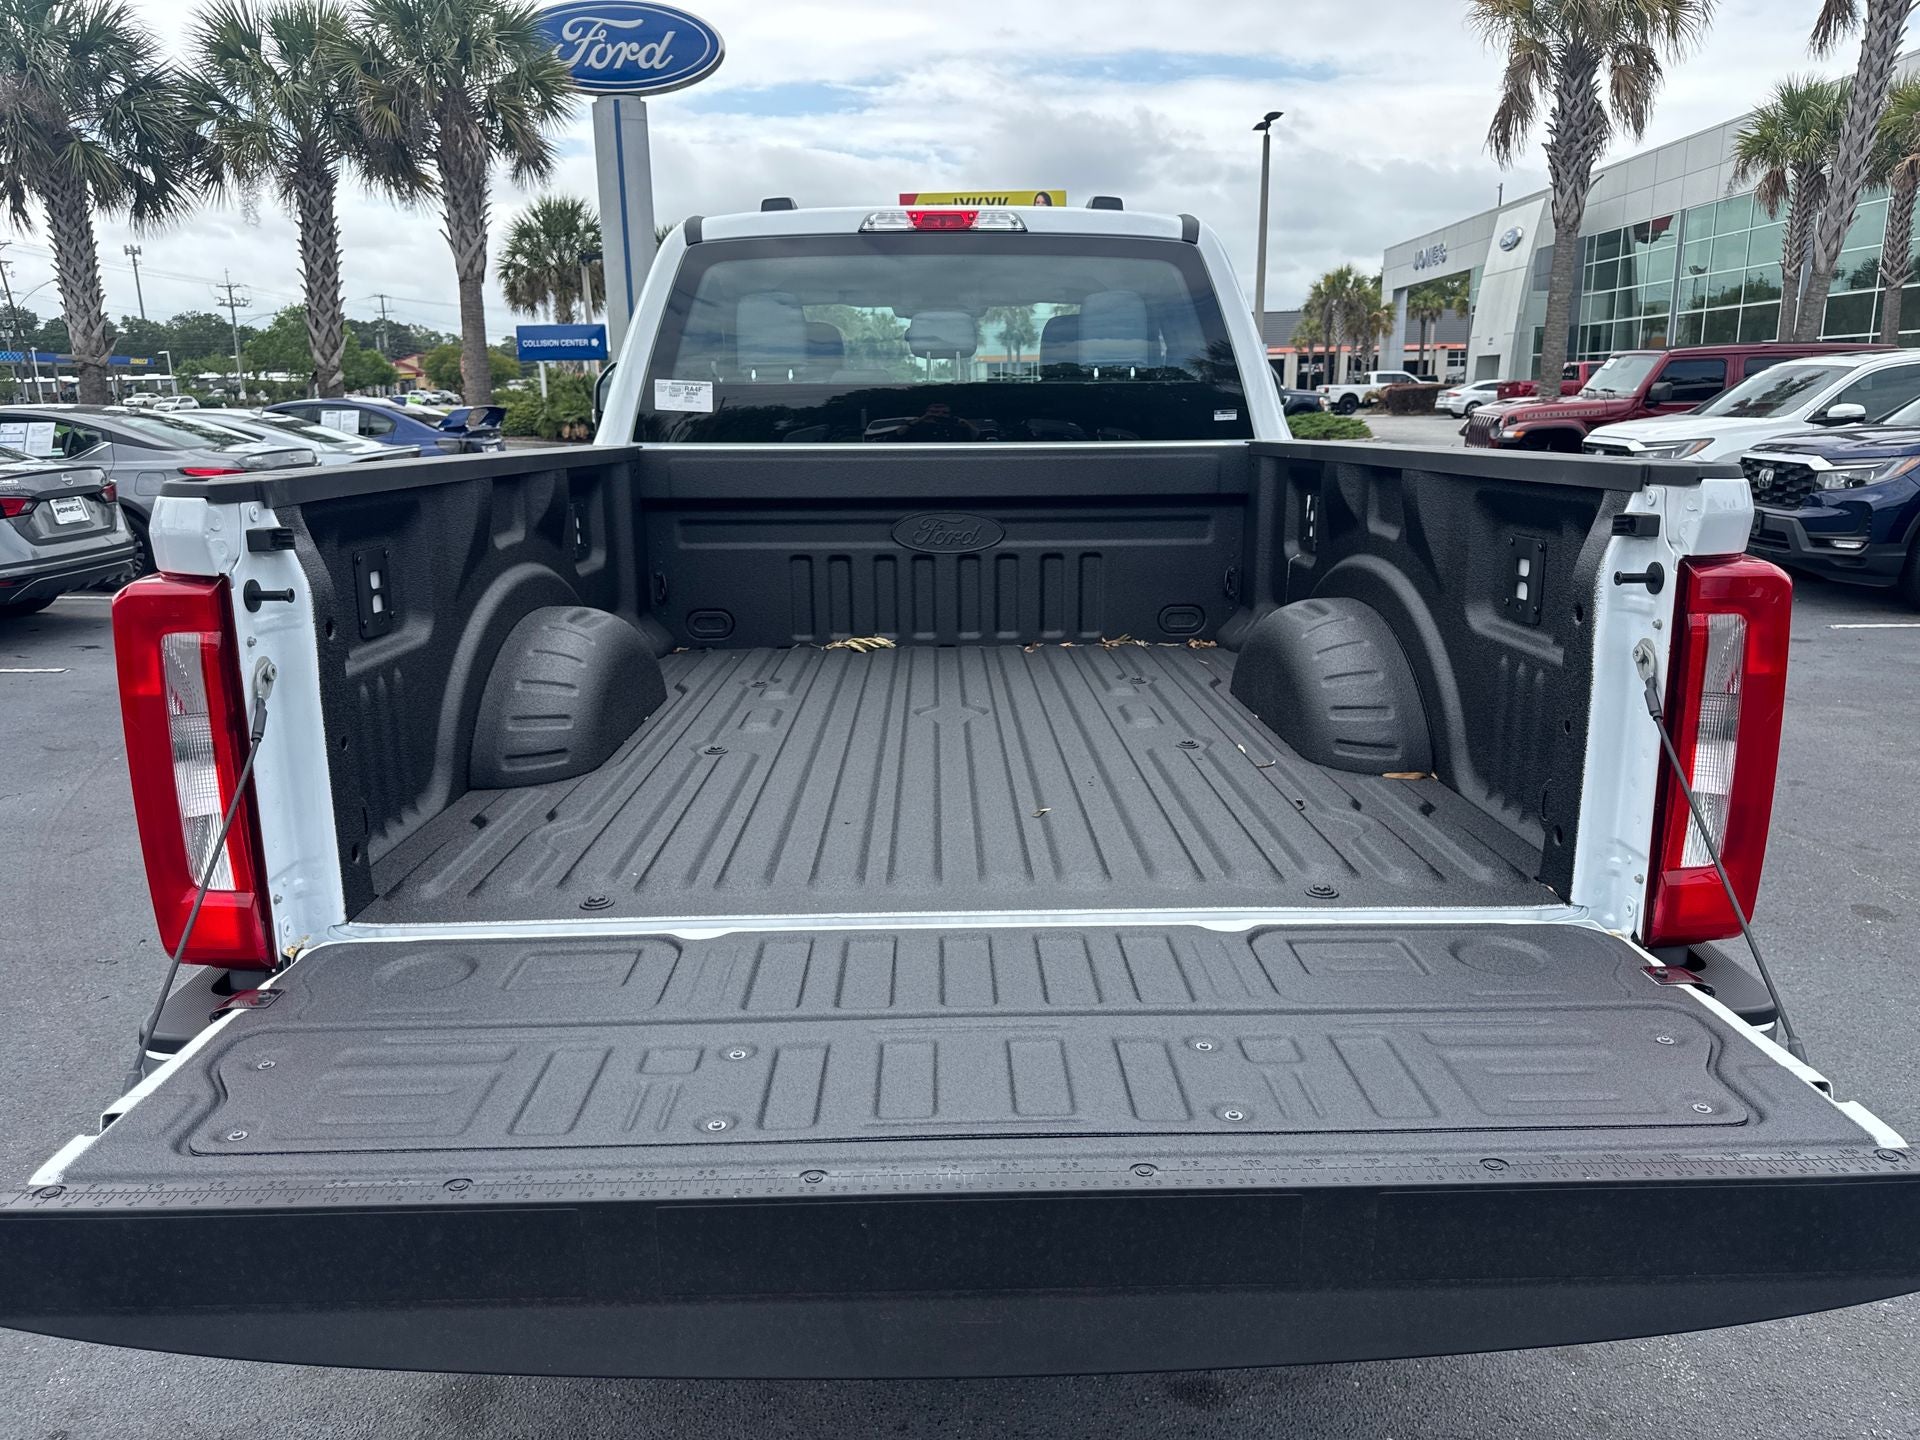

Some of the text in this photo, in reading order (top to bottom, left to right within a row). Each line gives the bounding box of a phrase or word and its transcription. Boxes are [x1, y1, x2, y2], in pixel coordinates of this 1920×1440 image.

[552, 16, 676, 70] Ford
[1413, 243, 1447, 271] JONES
[522, 338, 589, 348] COLLISION CENTER
[684, 385, 703, 393] RA4F
[912, 518, 983, 546] Ford
